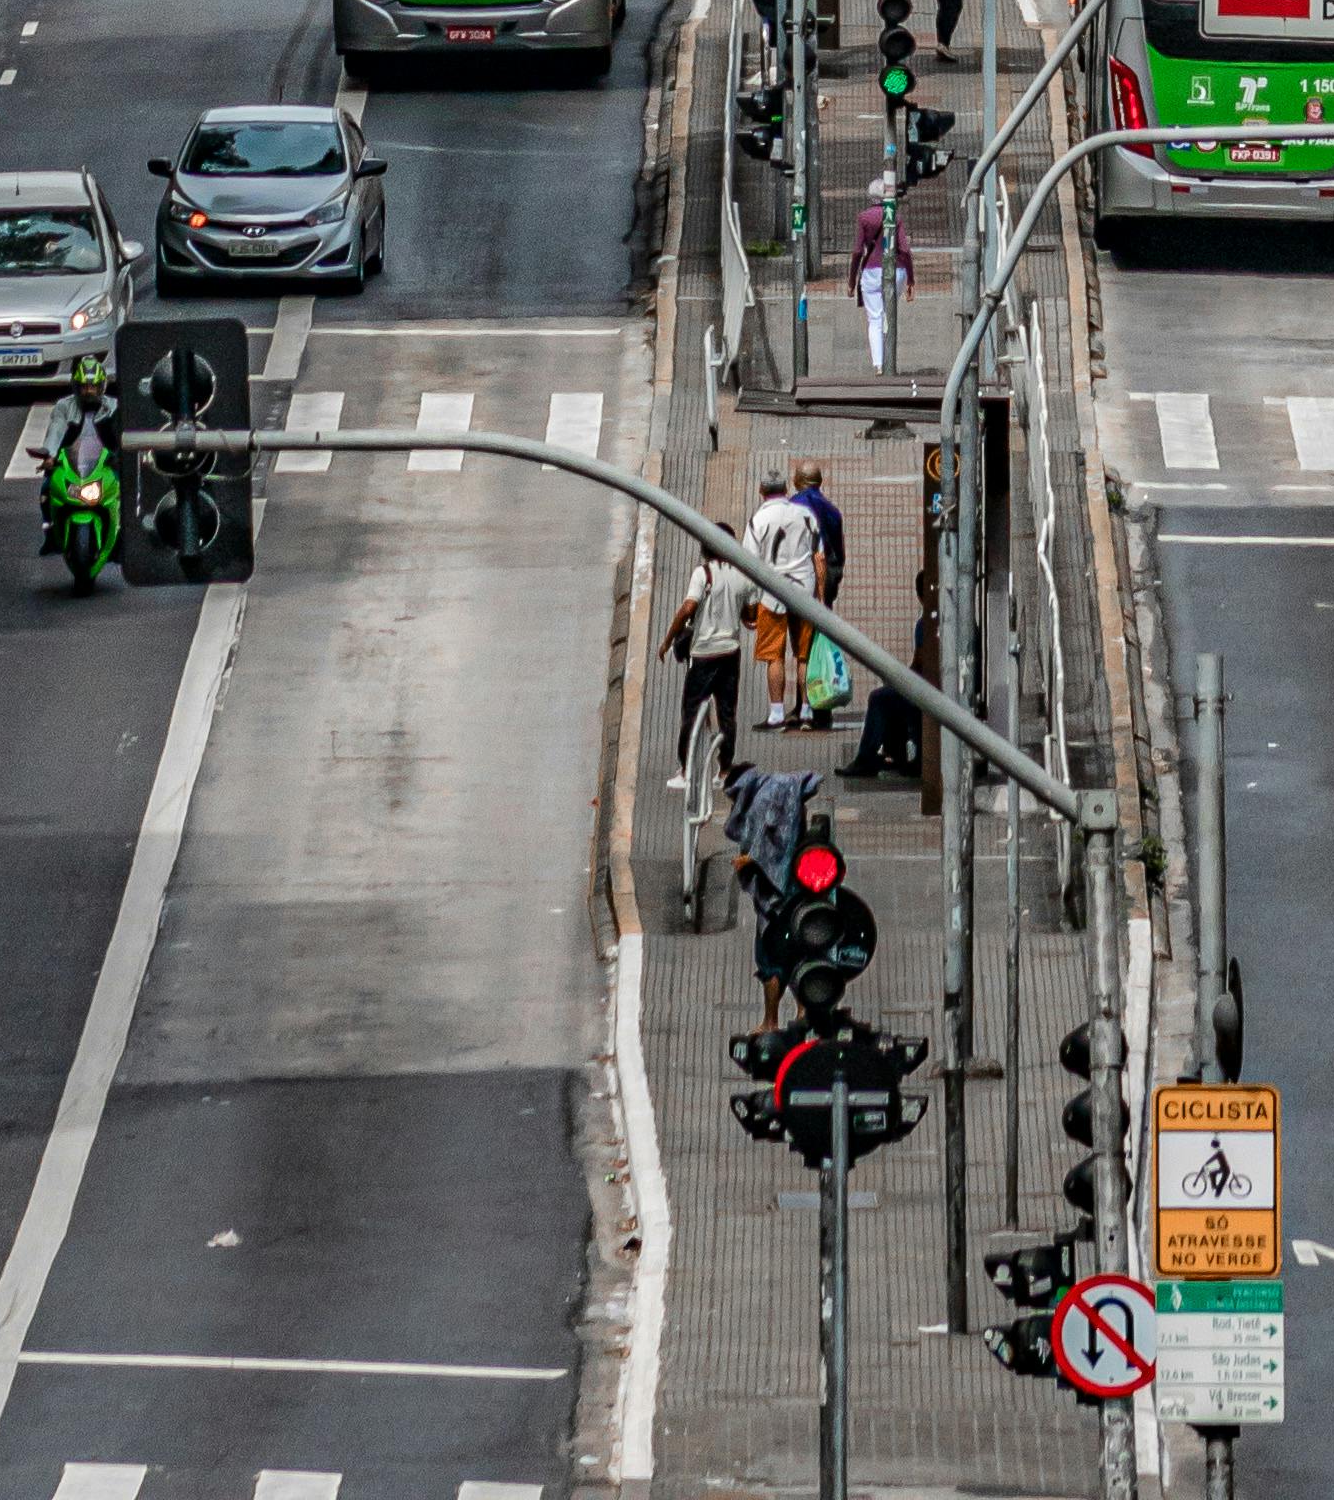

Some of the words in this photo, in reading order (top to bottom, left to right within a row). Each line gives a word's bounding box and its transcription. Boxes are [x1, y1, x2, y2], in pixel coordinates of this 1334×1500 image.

[1164, 1100, 1268, 1120] CICLISTA
[1205, 1215, 1229, 1229] SÓ
[1167, 1233, 1267, 1248] ATRAVESSE
[1172, 1253, 1196, 1266] NO
[1206, 1253, 1263, 1266] VERDE
